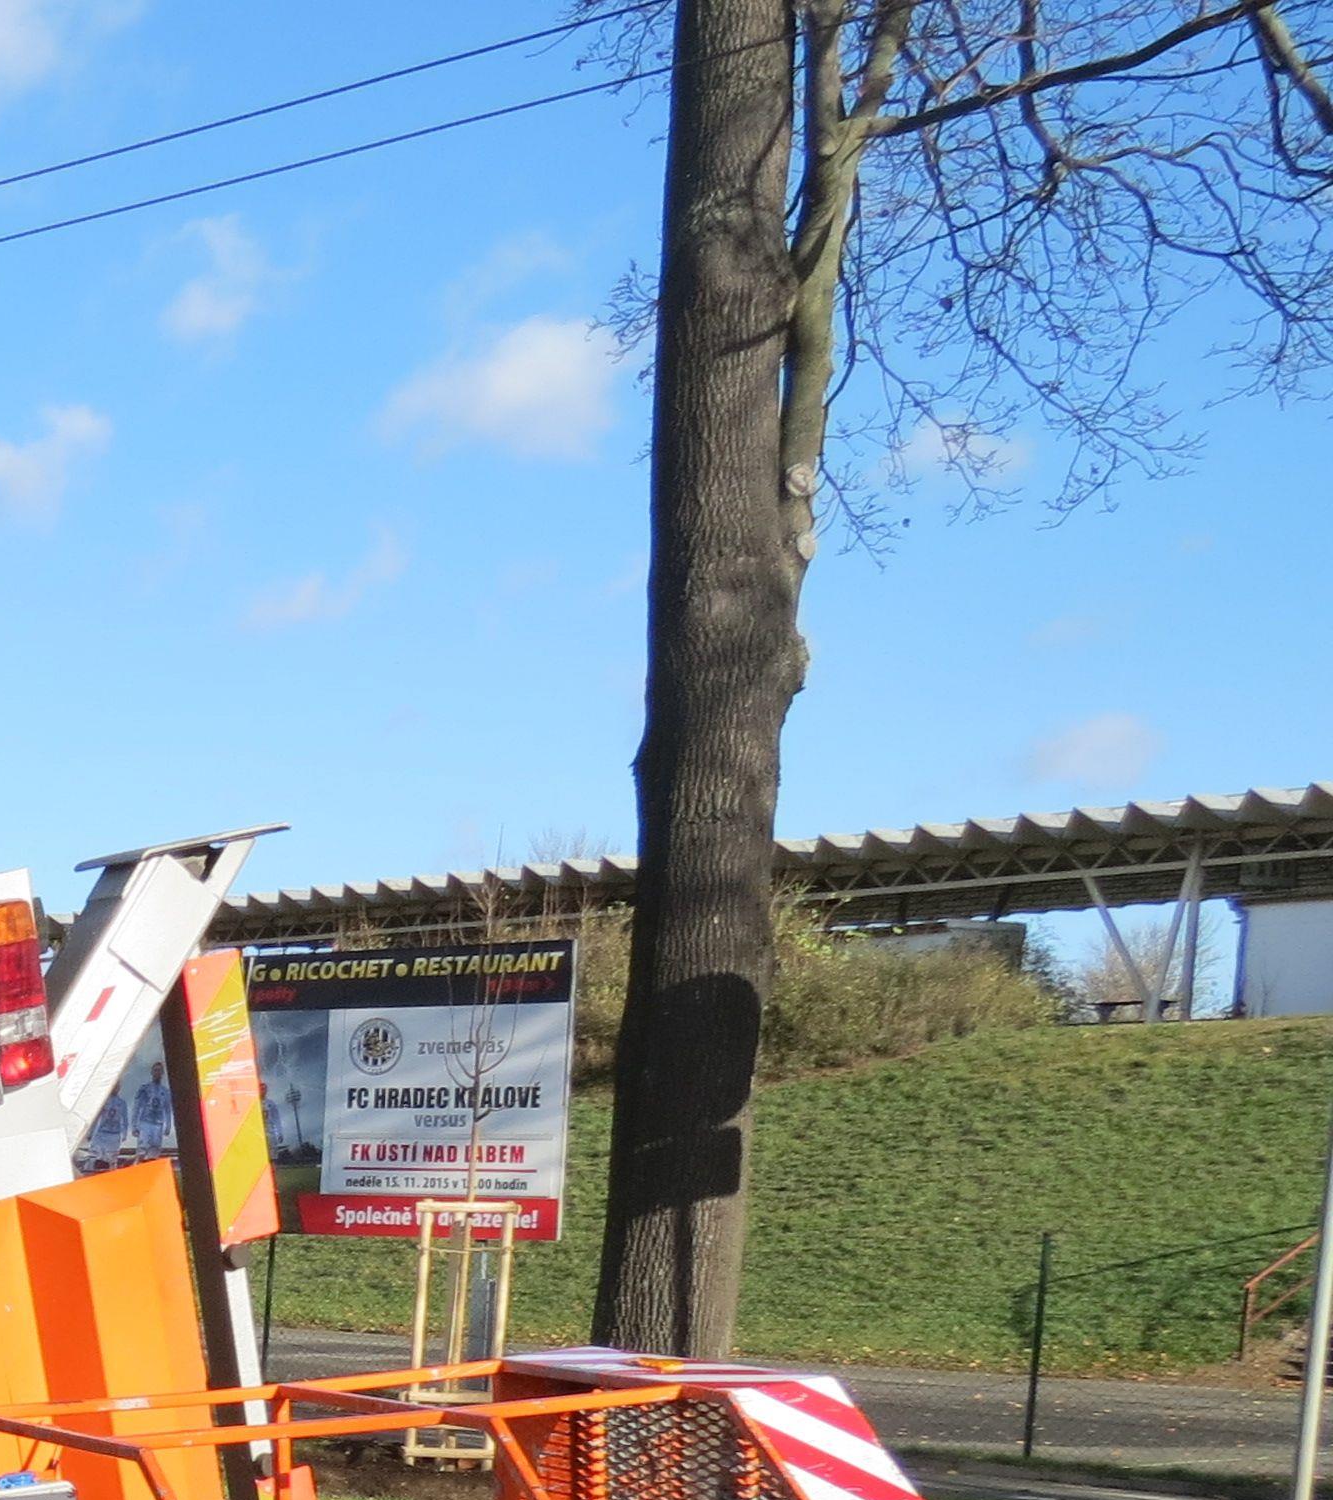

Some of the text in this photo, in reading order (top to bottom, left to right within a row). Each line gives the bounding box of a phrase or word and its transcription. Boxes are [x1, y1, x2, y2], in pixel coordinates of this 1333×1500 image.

[285, 958, 394, 981] RICOCHET
[412, 951, 566, 976] RESTAURANT
[417, 1040, 472, 1056] zveme
[346, 1087, 369, 1110] FC
[374, 1087, 449, 1109] HRADEC
[414, 1113, 467, 1128] versus
[350, 1143, 371, 1162] FK
[376, 1139, 419, 1162] ÚSTÍ
[422, 1144, 458, 1163] NAD
[404, 1177, 420, 1189] 11.
[423, 1177, 450, 1189] 2015
[452, 1180, 459, 1189] v
[462, 1178, 492, 1190] 1.00
[494, 1178, 528, 1190] hodin
[335, 1205, 412, 1227] Společně
